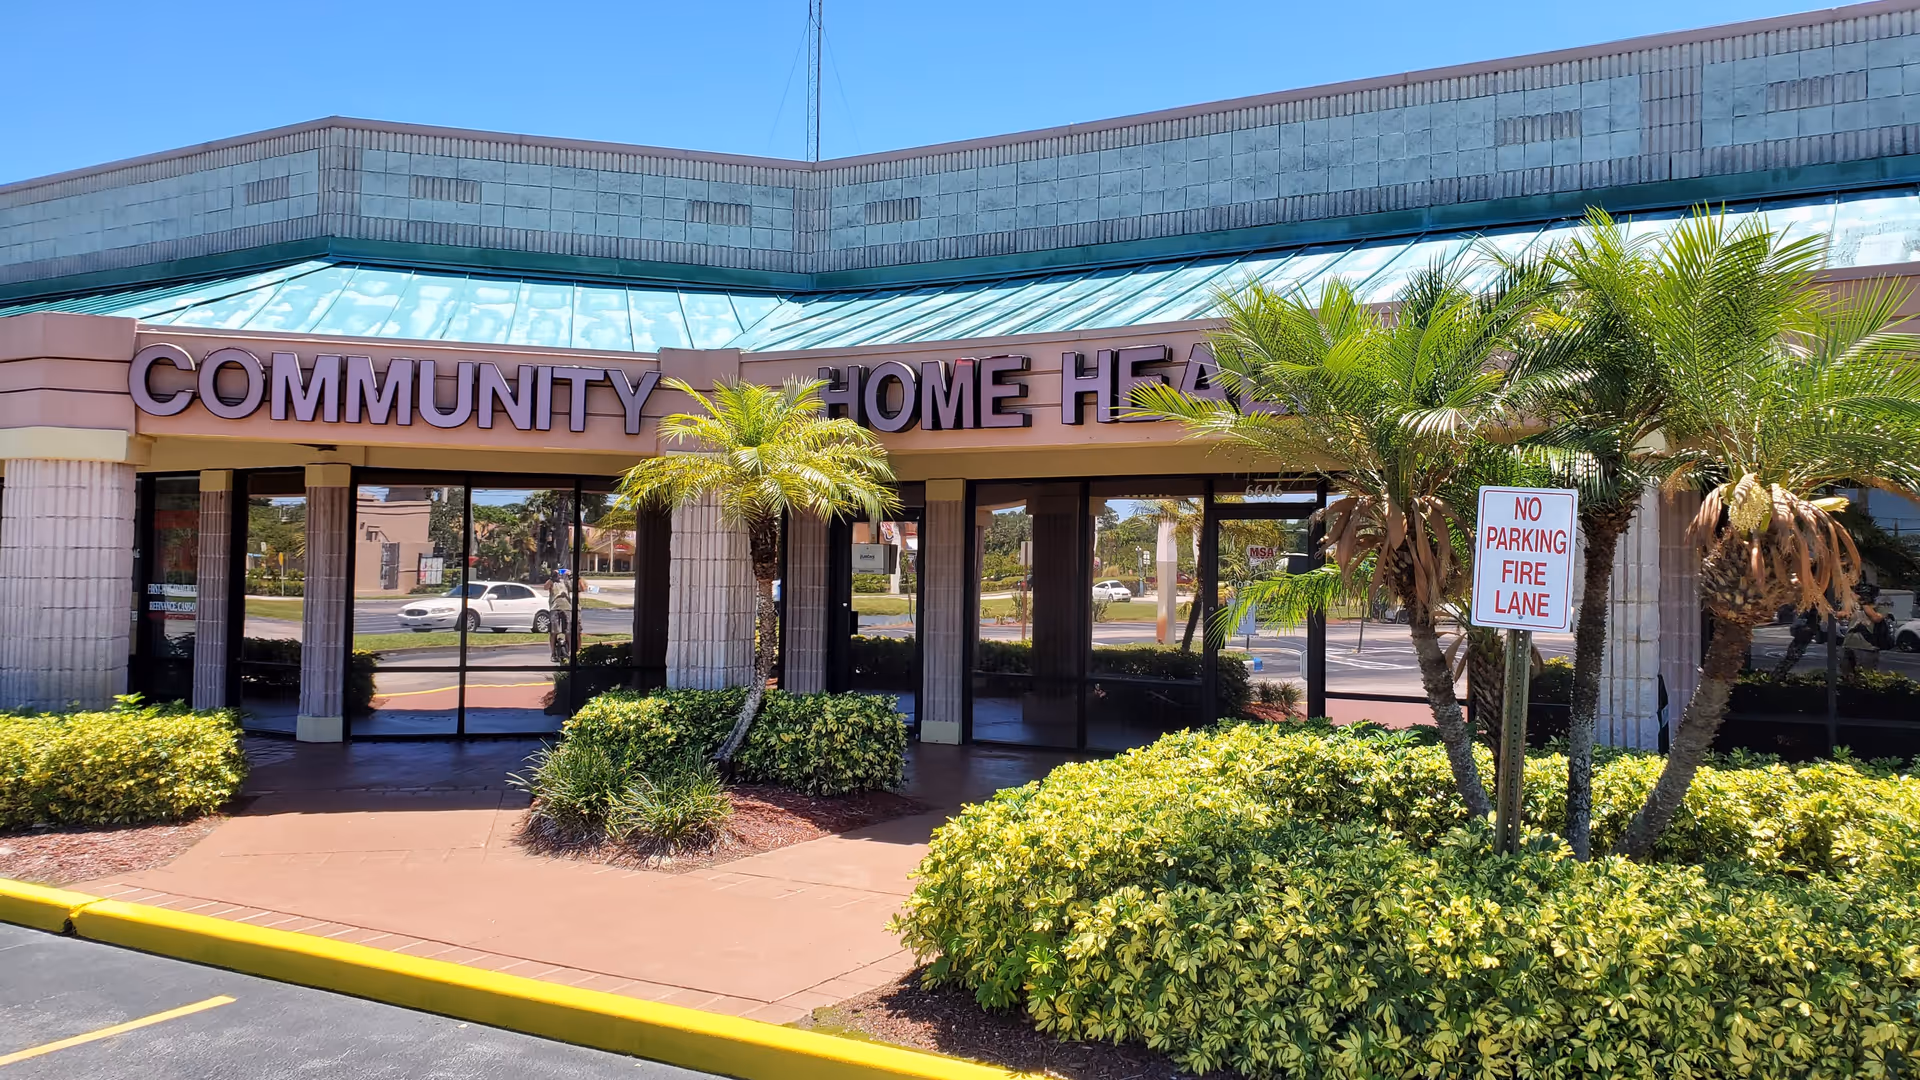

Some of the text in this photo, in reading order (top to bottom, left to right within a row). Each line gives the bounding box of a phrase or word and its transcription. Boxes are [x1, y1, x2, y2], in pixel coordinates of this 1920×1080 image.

[128, 342, 661, 435] COMMUNITY
[817, 354, 1033, 433] HOME
[1245, 484, 1283, 498] 6646
[1514, 497, 1542, 521] NO
[1249, 547, 1275, 557] MSA
[1486, 526, 1567, 555] PARKING
[1502, 560, 1547, 585] FIRE
[1495, 590, 1550, 617] LANE
